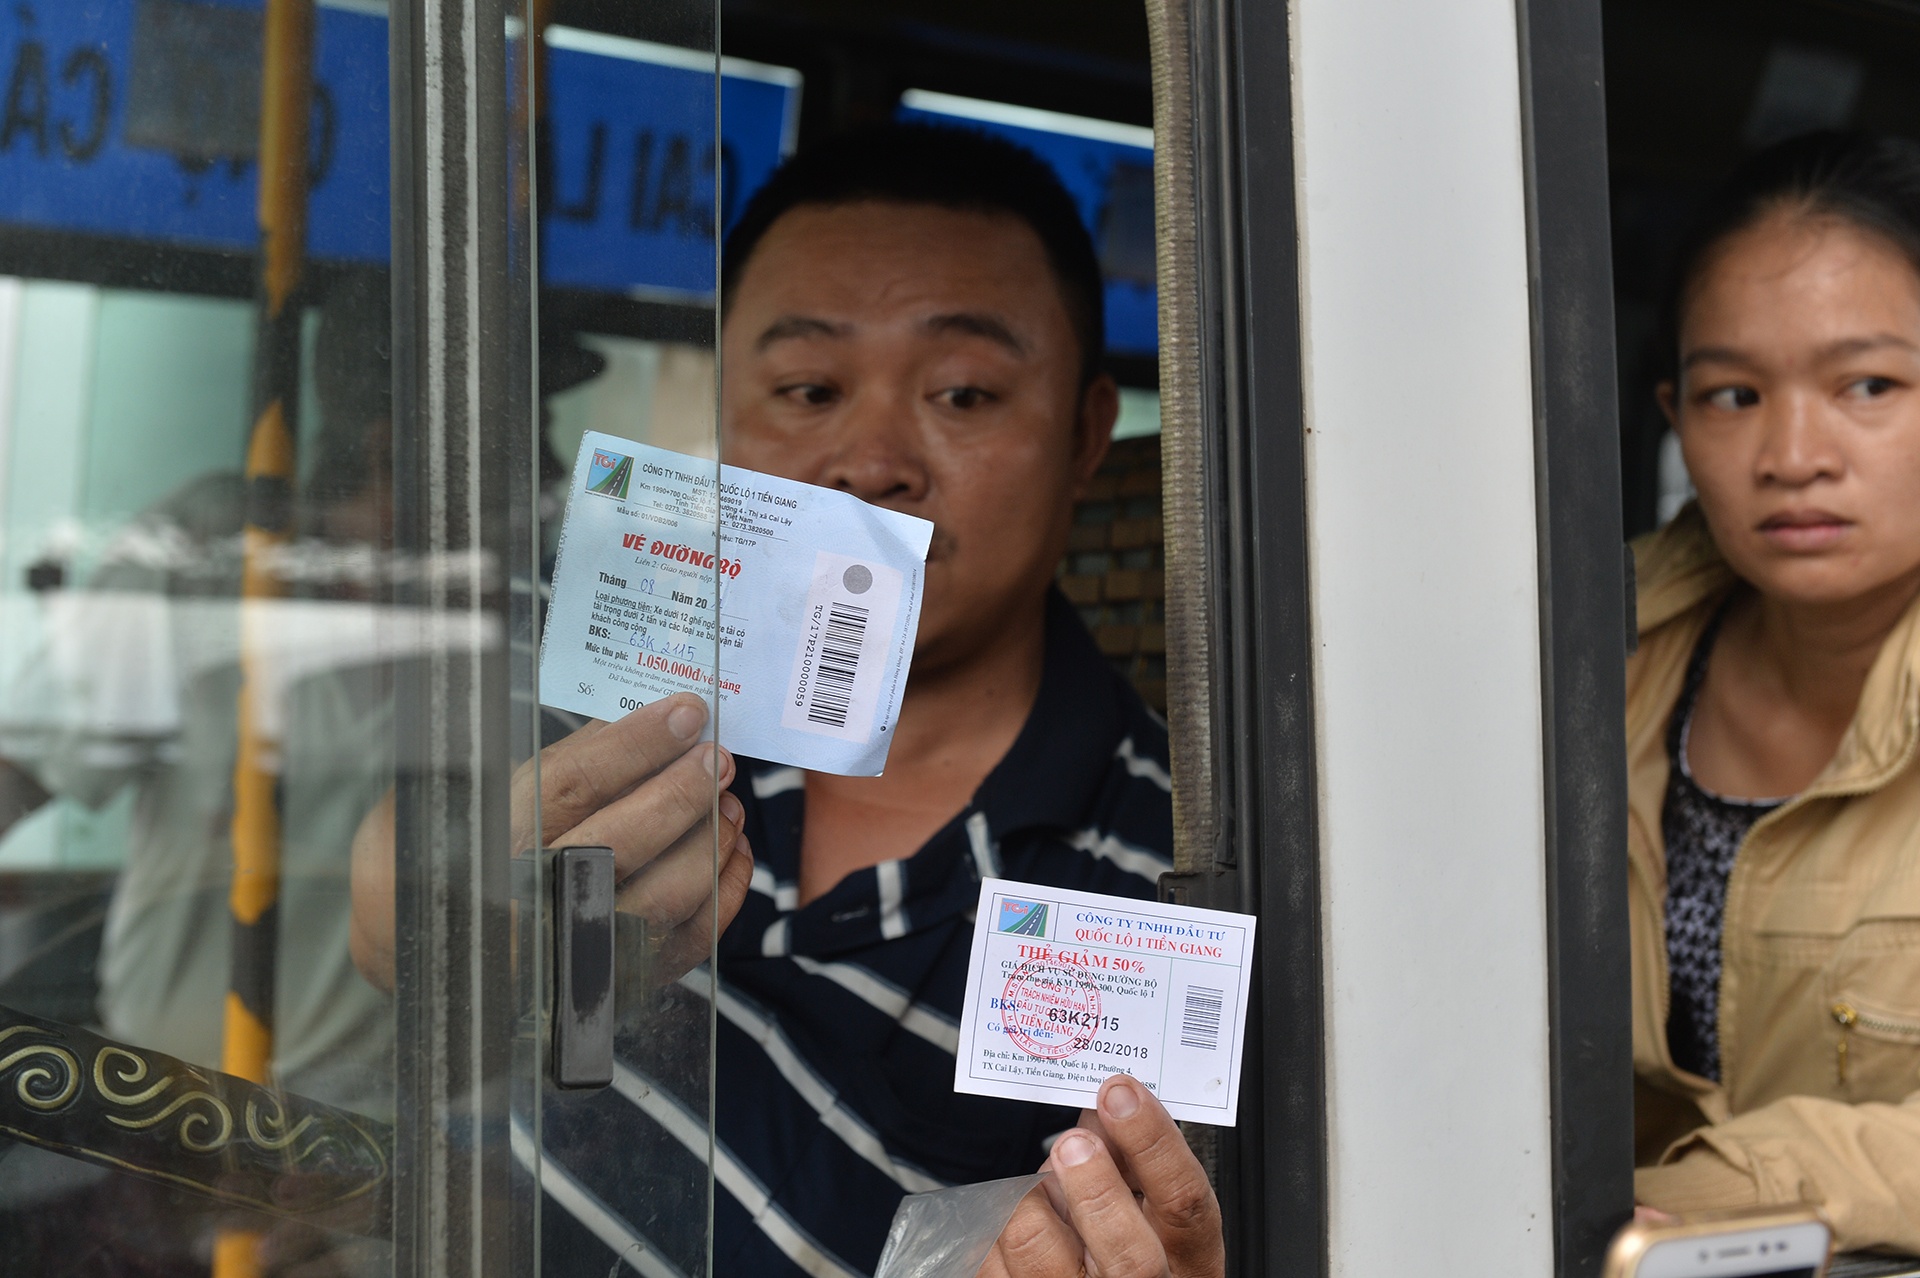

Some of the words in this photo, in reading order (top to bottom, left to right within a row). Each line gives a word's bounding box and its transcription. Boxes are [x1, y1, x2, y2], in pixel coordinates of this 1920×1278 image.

[642, 462, 663, 476] CÔNG
[664, 468, 673, 478] TY
[674, 471, 693, 483] TNHH
[718, 481, 739, 495] QUỐC
[739, 486, 750, 499] LỘ
[751, 491, 755, 499] 1
[774, 496, 797, 509] GIANG
[691, 487, 707, 496] MST:
[639, 482, 651, 490] Km
[747, 509, 758, 519] Thị
[768, 514, 779, 522] Cai
[725, 512, 737, 522] Việt
[738, 515, 753, 524] Nam
[622, 532, 646, 551] VÉ
[650, 539, 716, 569] ĐƯỜNG
[715, 557, 741, 579] BỘ
[634, 556, 650, 566] Liên
[659, 562, 677, 573] Giao
[598, 571, 627, 589] Tháng
[671, 590, 693, 605] Năm
[639, 577, 655, 595] 08
[590, 611, 611, 624] khách
[612, 617, 629, 630] công
[594, 589, 610, 602] Loại
[609, 594, 636, 609] phương
[653, 604, 663, 614] Xe
[663, 608, 679, 619] dưới
[680, 612, 688, 621] 12
[688, 615, 703, 626] ghế
[735, 628, 745, 637] có
[603, 604, 621, 617] trọng
[623, 608, 639, 619] dưới
[639, 613, 645, 621] 2
[658, 618, 667, 627] và
[668, 621, 680, 631] các
[695, 630, 704, 638] xe
[588, 624, 611, 639] BKS:
[629, 631, 655, 652] 63K
[584, 641, 600, 653] Mức
[601, 646, 613, 657] thu
[592, 656, 607, 666] Một
[623, 665, 644, 677] không
[576, 681, 595, 696] Số:
[608, 672, 619, 681] Đã
[619, 675, 632, 685] bao
[1076, 911, 1112, 925] CÔNG
[1116, 918, 1133, 928] TY
[1136, 921, 1172, 934] TNHH
[1176, 923, 1204, 938] ĐẦU
[1207, 930, 1225, 941] TƯ
[1074, 926, 1112, 943] QUỐC
[1115, 931, 1133, 947] LỘ
[1136, 937, 1142, 947] 1
[1145, 934, 1176, 951] TIỀN
[1179, 942, 1221, 958] GIANG
[1017, 942, 1052, 961] THẺ
[1057, 948, 1108, 968] GIẢM
[1112, 957, 1145, 973] 50%
[1000, 959, 1018, 970] GIÁ
[1047, 966, 1060, 976] VỤ
[1107, 974, 1141, 986] ĐƯỜNG
[1144, 978, 1157, 989] BỘ
[1020, 986, 1040, 1000] TRÁCH
[1056, 978, 1072, 987] KM
[1116, 985, 1138, 996] Quốc
[1139, 989, 1148, 998] lộ
[1064, 986, 1076, 996] TY
[1042, 1020, 1074, 1036] GIANG
[1048, 1008, 1119, 1031] 63K2115
[986, 1021, 1000, 1032] Có
[1073, 1037, 1148, 1059] 28/02/2018
[982, 1061, 993, 1070] TX
[994, 1063, 1007, 1072] Cai
[1067, 1072, 1085, 1082] Điện
[983, 1048, 996, 1058] Địa
[1011, 1052, 1024, 1061] Km
[1060, 1057, 1080, 1068] Quốc
[1080, 1061, 1088, 1070] lộ
[1097, 1063, 1125, 1075] Phường
